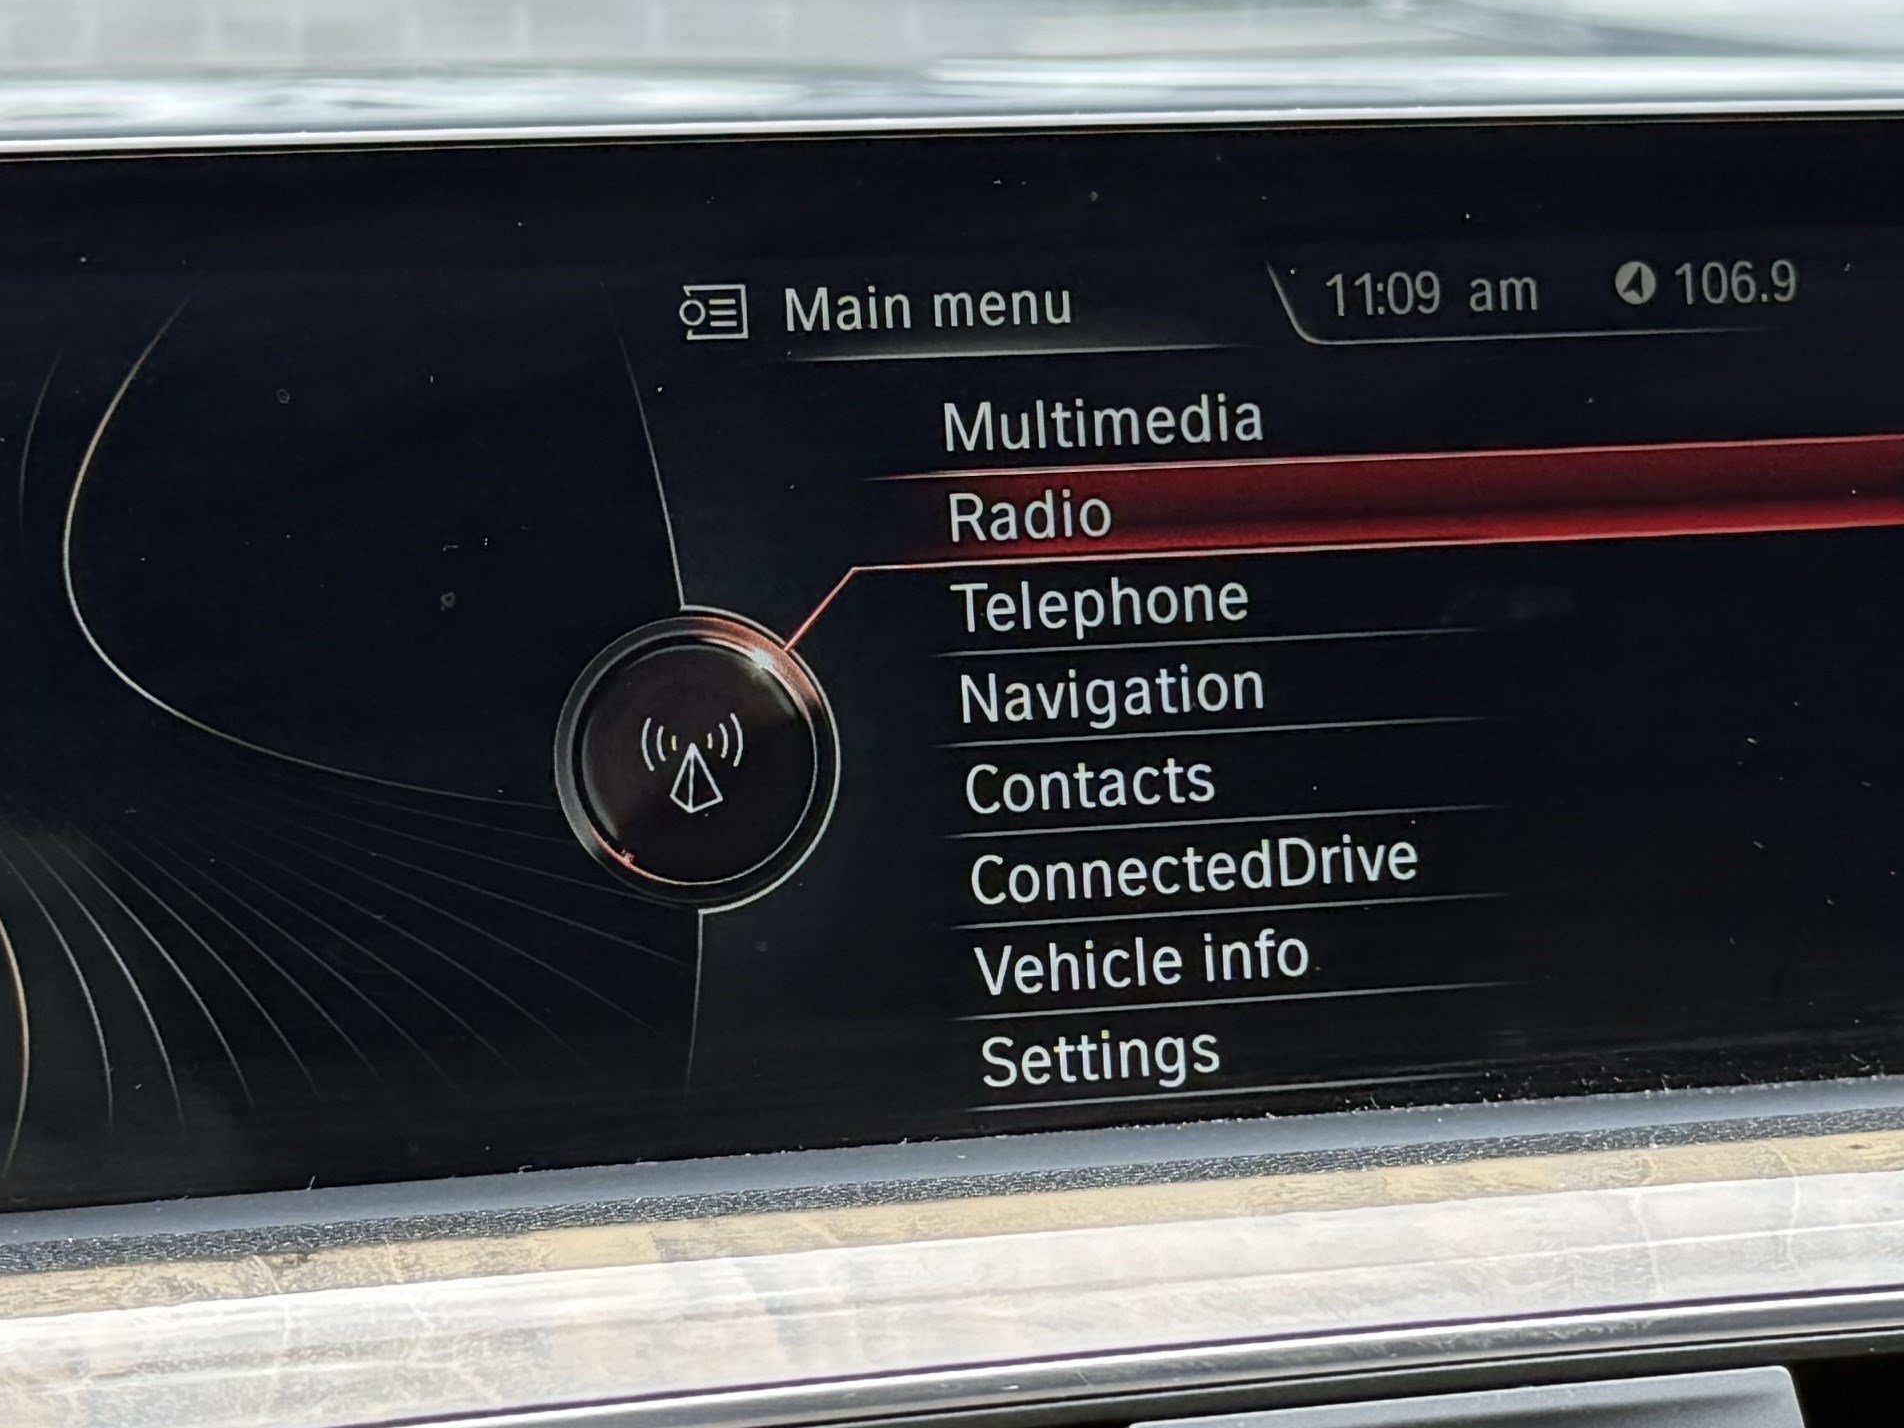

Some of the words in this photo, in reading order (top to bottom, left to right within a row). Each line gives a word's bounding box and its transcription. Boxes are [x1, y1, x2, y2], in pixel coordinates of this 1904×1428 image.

[784, 284, 912, 333] Main
[932, 286, 1072, 329] menu
[1324, 269, 1442, 318] 11:09
[1468, 275, 1539, 313] am
[1674, 258, 1797, 306] 106.9
[942, 392, 1264, 453] Multimedia
[948, 487, 1113, 544] Radio
[949, 575, 1249, 641] Telephone
[959, 663, 1266, 730] Navigation
[965, 756, 1216, 815] Contacts
[970, 833, 1419, 906] ConnectedDrive
[972, 935, 1184, 997] Vehicle
[1202, 927, 1310, 983] info
[981, 1028, 1221, 1089] Settings
